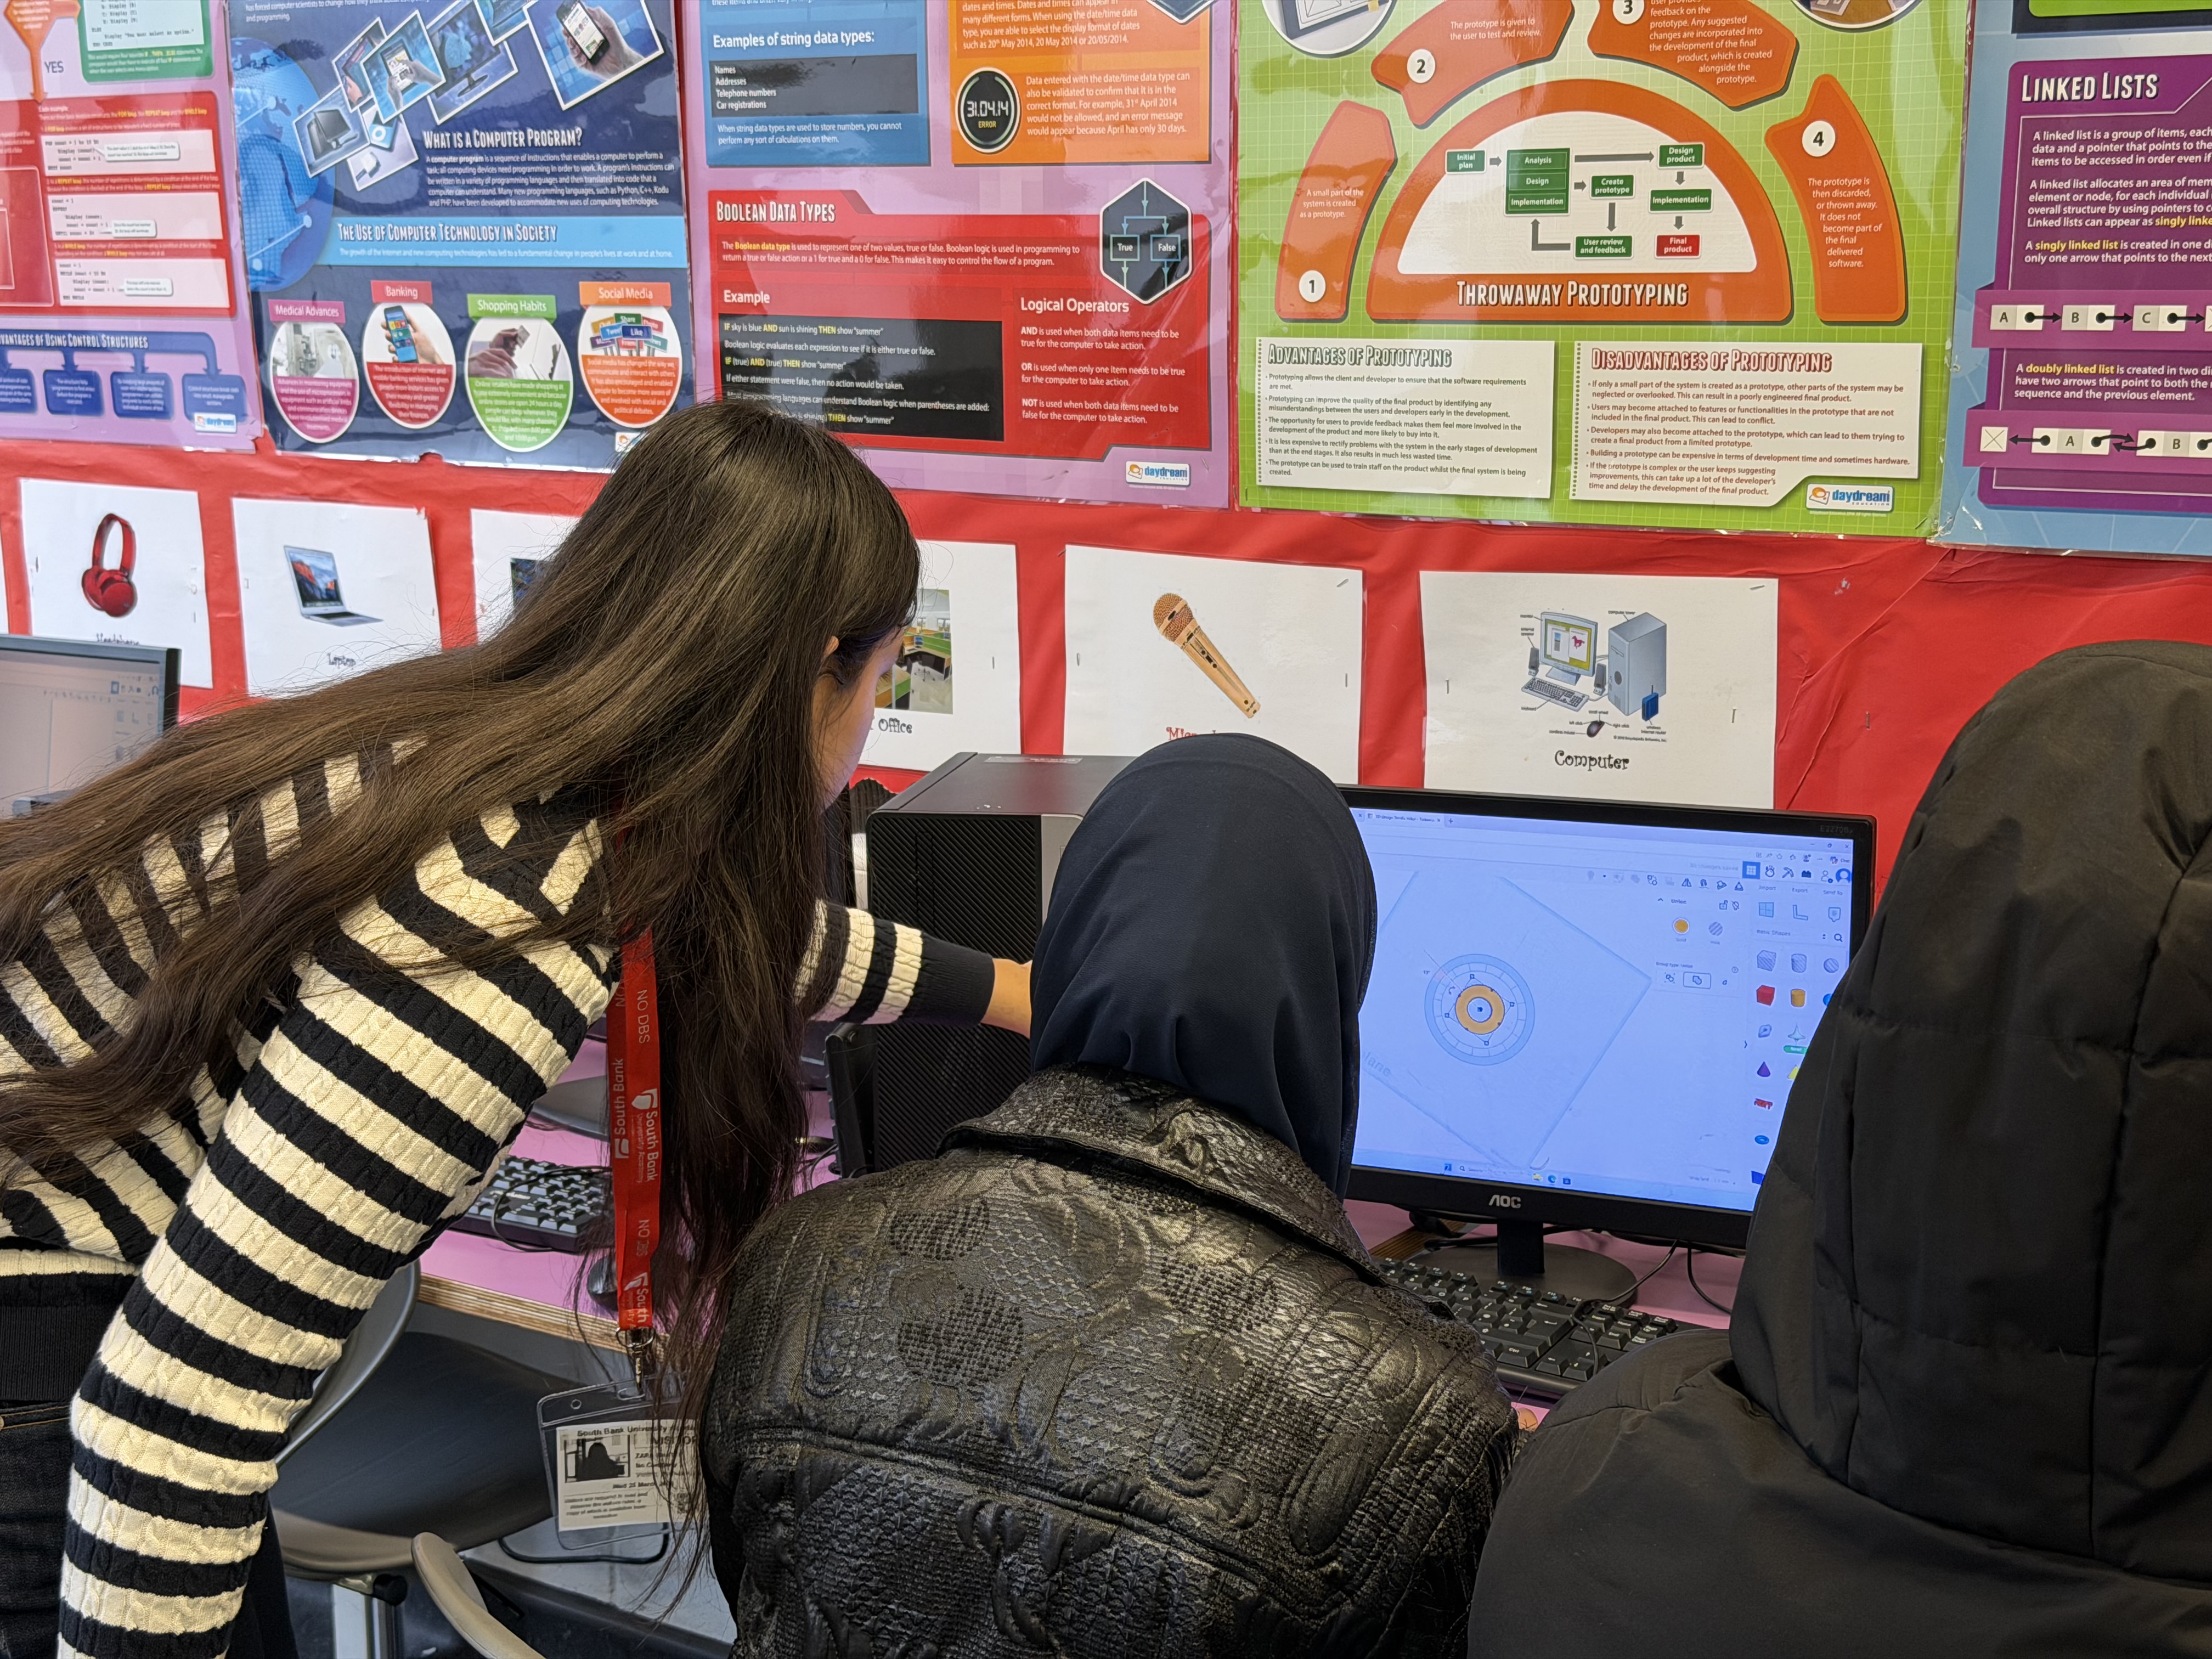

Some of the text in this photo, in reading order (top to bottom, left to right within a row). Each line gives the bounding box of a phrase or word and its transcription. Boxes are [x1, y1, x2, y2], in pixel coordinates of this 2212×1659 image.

[1620, 0, 1637, 14] 3
[713, 30, 874, 49] Examples of string data types:
[45, 61, 64, 73] YES
[714, 65, 736, 74] Names
[1417, 59, 1425, 74] 2
[715, 77, 747, 85] Addresses
[2022, 72, 2157, 101] LINKED LISTS
[715, 88, 776, 99] Telephone numbers
[716, 100, 766, 111] Car registrations
[967, 100, 1009, 117] 31.04.14
[422, 126, 585, 148] WHAT IS A COMPUTER PROGRAM?
[1027, 123, 1186, 137] would appear because April has only 30 days.
[2033, 131, 2040, 140] A
[2043, 130, 2074, 140] linked
[2076, 129, 2091, 139] list
[2094, 129, 2101, 139] is
[2112, 131, 2142, 141] group
[2144, 127, 2156, 138] of
[2157, 128, 2187, 138] items,
[2190, 126, 2212, 137] each
[1813, 131, 1824, 146] 4
[1457, 153, 1475, 162] Initial
[1669, 146, 1693, 155] Design
[1459, 161, 1472, 170] plan
[1525, 156, 1551, 165] Analysis
[1667, 155, 1695, 163] product
[1526, 177, 1549, 186] Design
[1601, 178, 1623, 187] Create
[1808, 178, 1821, 186] The
[1824, 178, 1862, 188] prototype
[1595, 187, 1630, 195] prototype
[1511, 197, 1564, 207] Implementation
[1652, 195, 1708, 205] Implementation
[716, 201, 834, 223] BOOLEAN DATA TYPES
[337, 222, 559, 243] THE USE OF COMPUTER TECHNOLOGY IN SOCIETY
[1158, 244, 1176, 252] False
[1580, 245, 1626, 253] and feedback
[1584, 238, 1624, 247] User review
[1664, 245, 1692, 255] product
[385, 285, 417, 300] Banking
[1309, 279, 1314, 293] 1
[599, 287, 656, 302] Social Media
[724, 290, 770, 306] Example
[1457, 281, 1688, 308] THROWAWAY PROTOTYPING
[274, 304, 339, 317] Medical Advances
[476, 299, 546, 314] Shopping Habits
[1021, 297, 1129, 314] Logical Operators
[1999, 312, 2008, 323] A
[2072, 312, 2079, 323] B
[2142, 312, 2151, 323] C
[731, 323, 741, 332] sky
[748, 323, 762, 331] blue
[763, 324, 777, 332] AND
[796, 325, 817, 335] shining
[818, 325, 836, 334] THEN
[854, 327, 883, 335] "summer"
[1020, 326, 1037, 335] AND
[1045, 327, 1062, 335] used
[1063, 328, 1082, 336] when
[1084, 328, 1101, 336] both
[1102, 327, 1118, 337] data
[1120, 329, 1139, 337] items
[1141, 329, 1160, 339] need
[1160, 328, 1169, 337] to
[1170, 329, 1179, 338] be
[35, 334, 43, 346] OF
[44, 333, 66, 346] USING
[67, 334, 100, 347] CONTROL
[101, 334, 148, 348] STRUCTURES
[1268, 343, 1452, 368] ADVANTAGES OF PROTOTYPING
[1592, 348, 1832, 373] DISADVANTAGES OF PROTOTYPING
[2066, 436, 2074, 446] A
[2172, 438, 2180, 449] B
[1144, 466, 1188, 478] daydream
[1832, 489, 1890, 503] daydream
[327, 653, 356, 670] Laptop
[878, 718, 912, 733] Office
[1553, 748, 1630, 771] Computer
[637, 989, 650, 1043] NO DBS
[613, 1058, 625, 1136] South Bank
[646, 1110, 658, 1182] South Bank
[1488, 1194, 1521, 1209] AOC
[636, 1219, 650, 1238] NO
[636, 1288, 648, 1324] South
